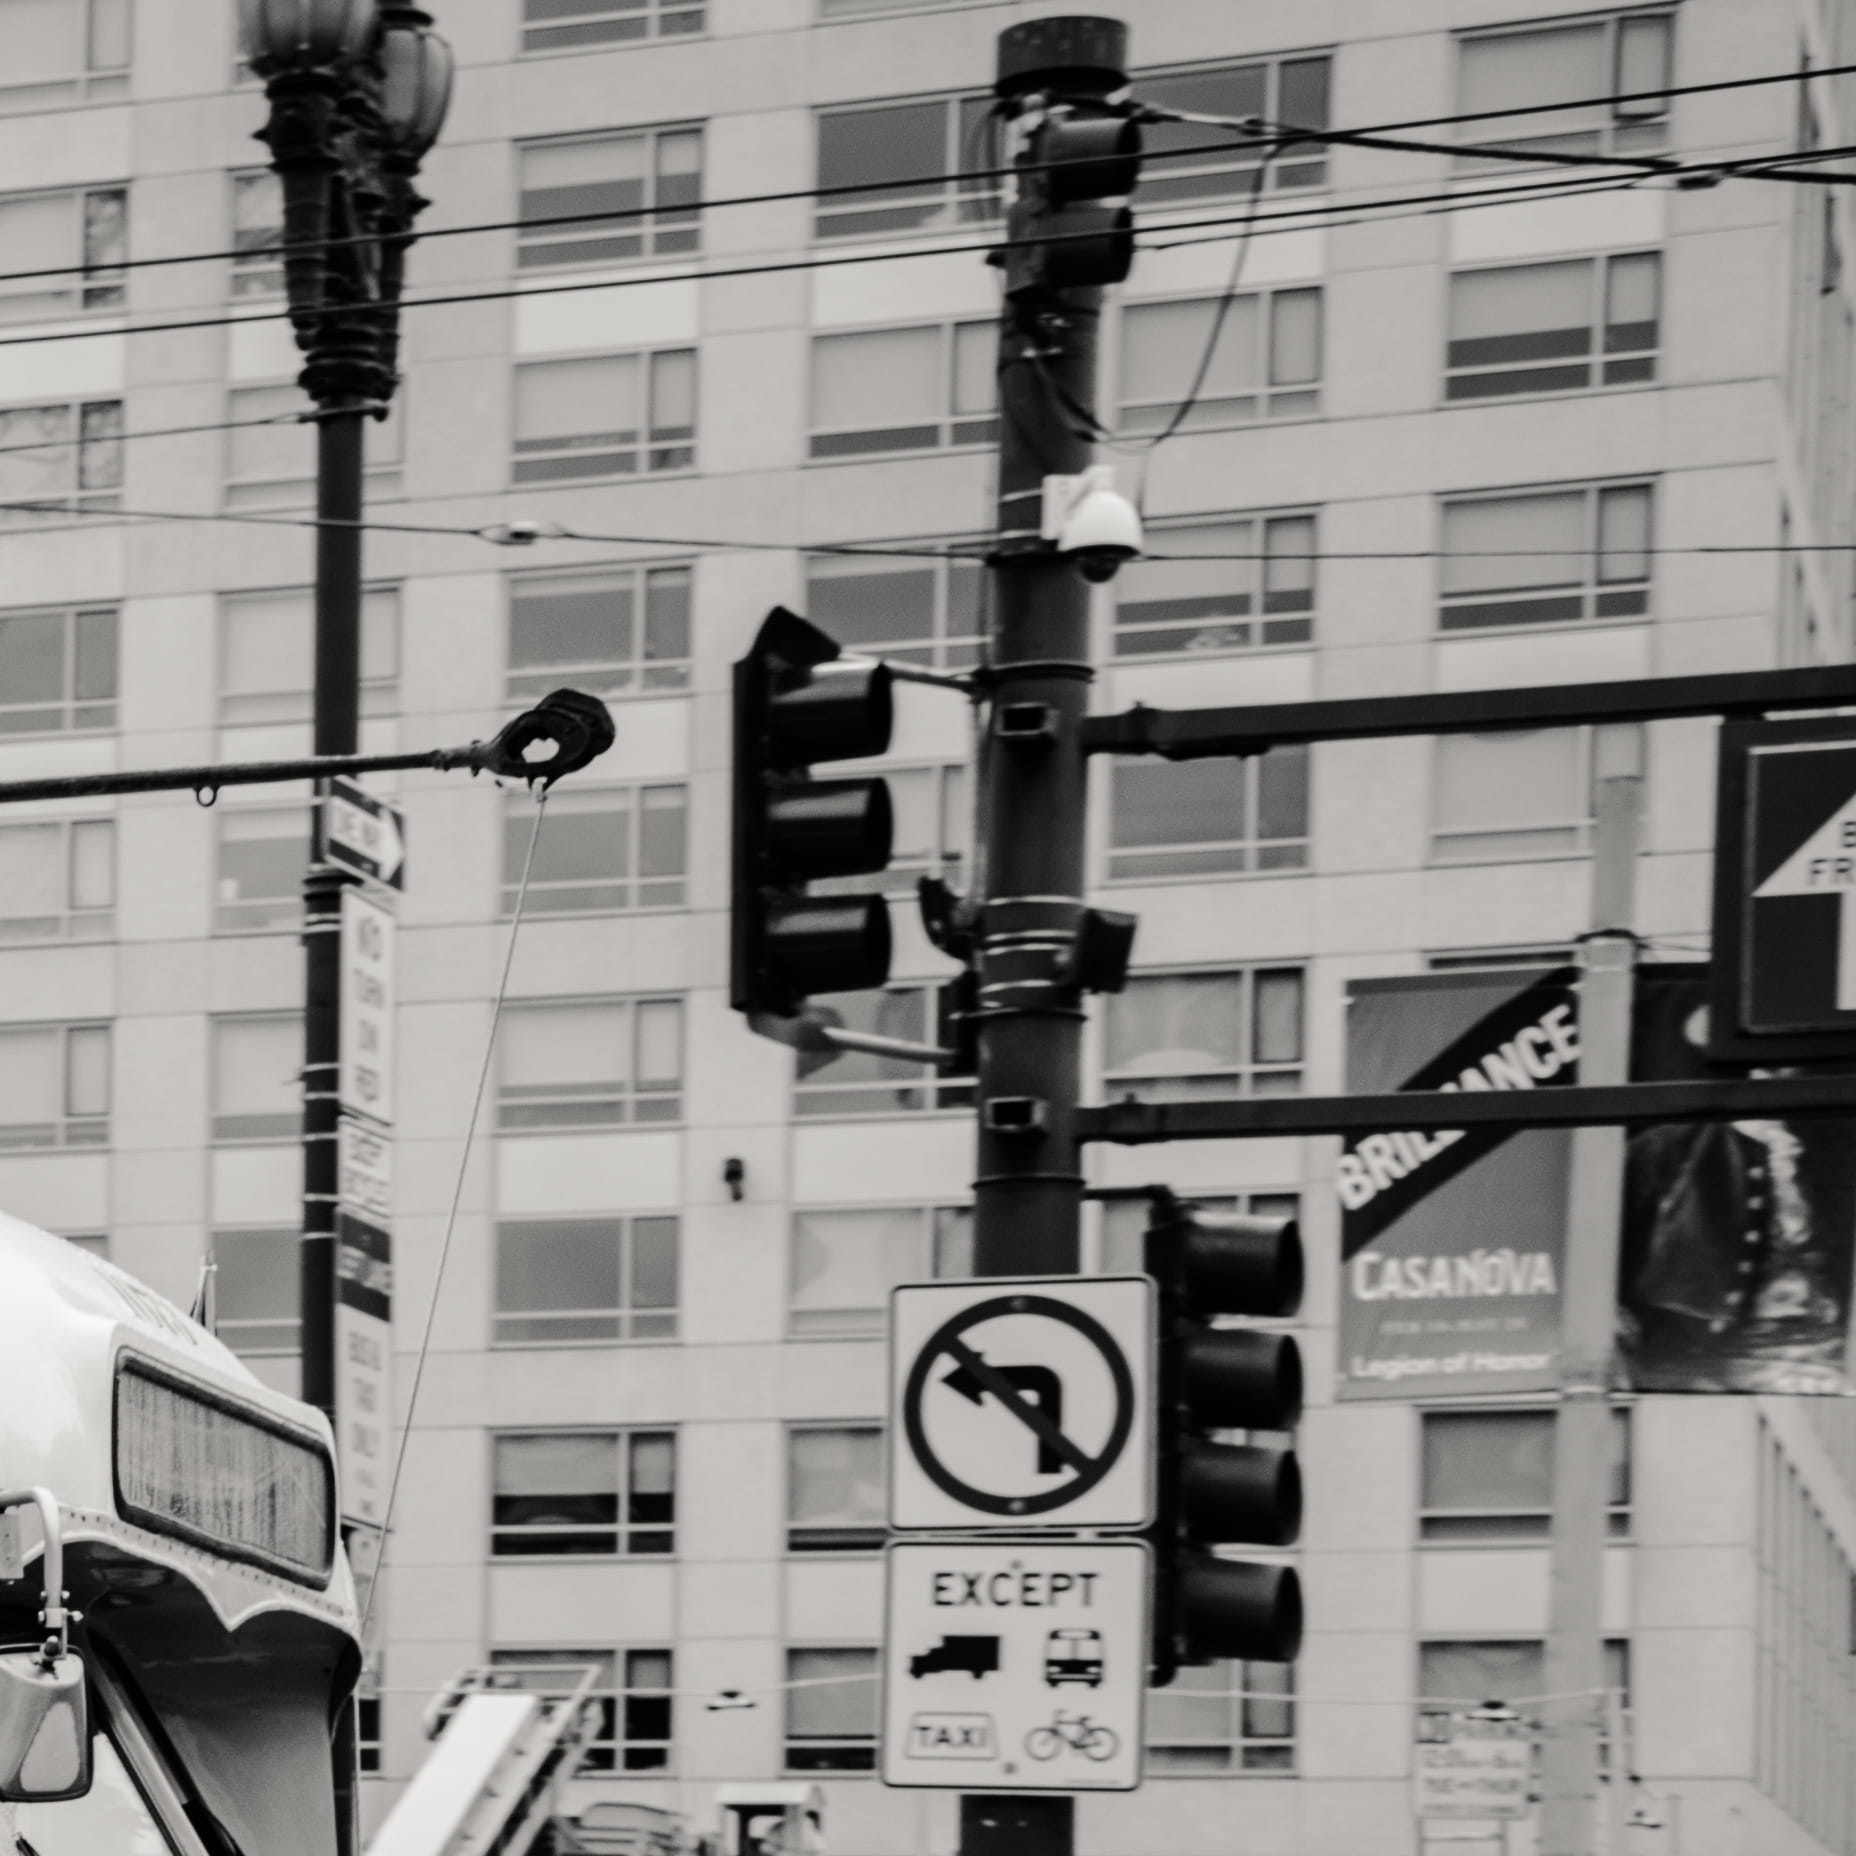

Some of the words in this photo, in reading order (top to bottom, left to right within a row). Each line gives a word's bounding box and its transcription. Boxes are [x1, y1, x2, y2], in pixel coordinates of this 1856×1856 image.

[1352, 1248, 1557, 1300] CASANOVA
[1350, 1355, 1438, 1381] Legion
[1441, 1353, 1468, 1372] of
[1471, 1351, 1552, 1371] Honor
[932, 1572, 1098, 1607] EXCEPT
[915, 1725, 988, 1748] TAXI
